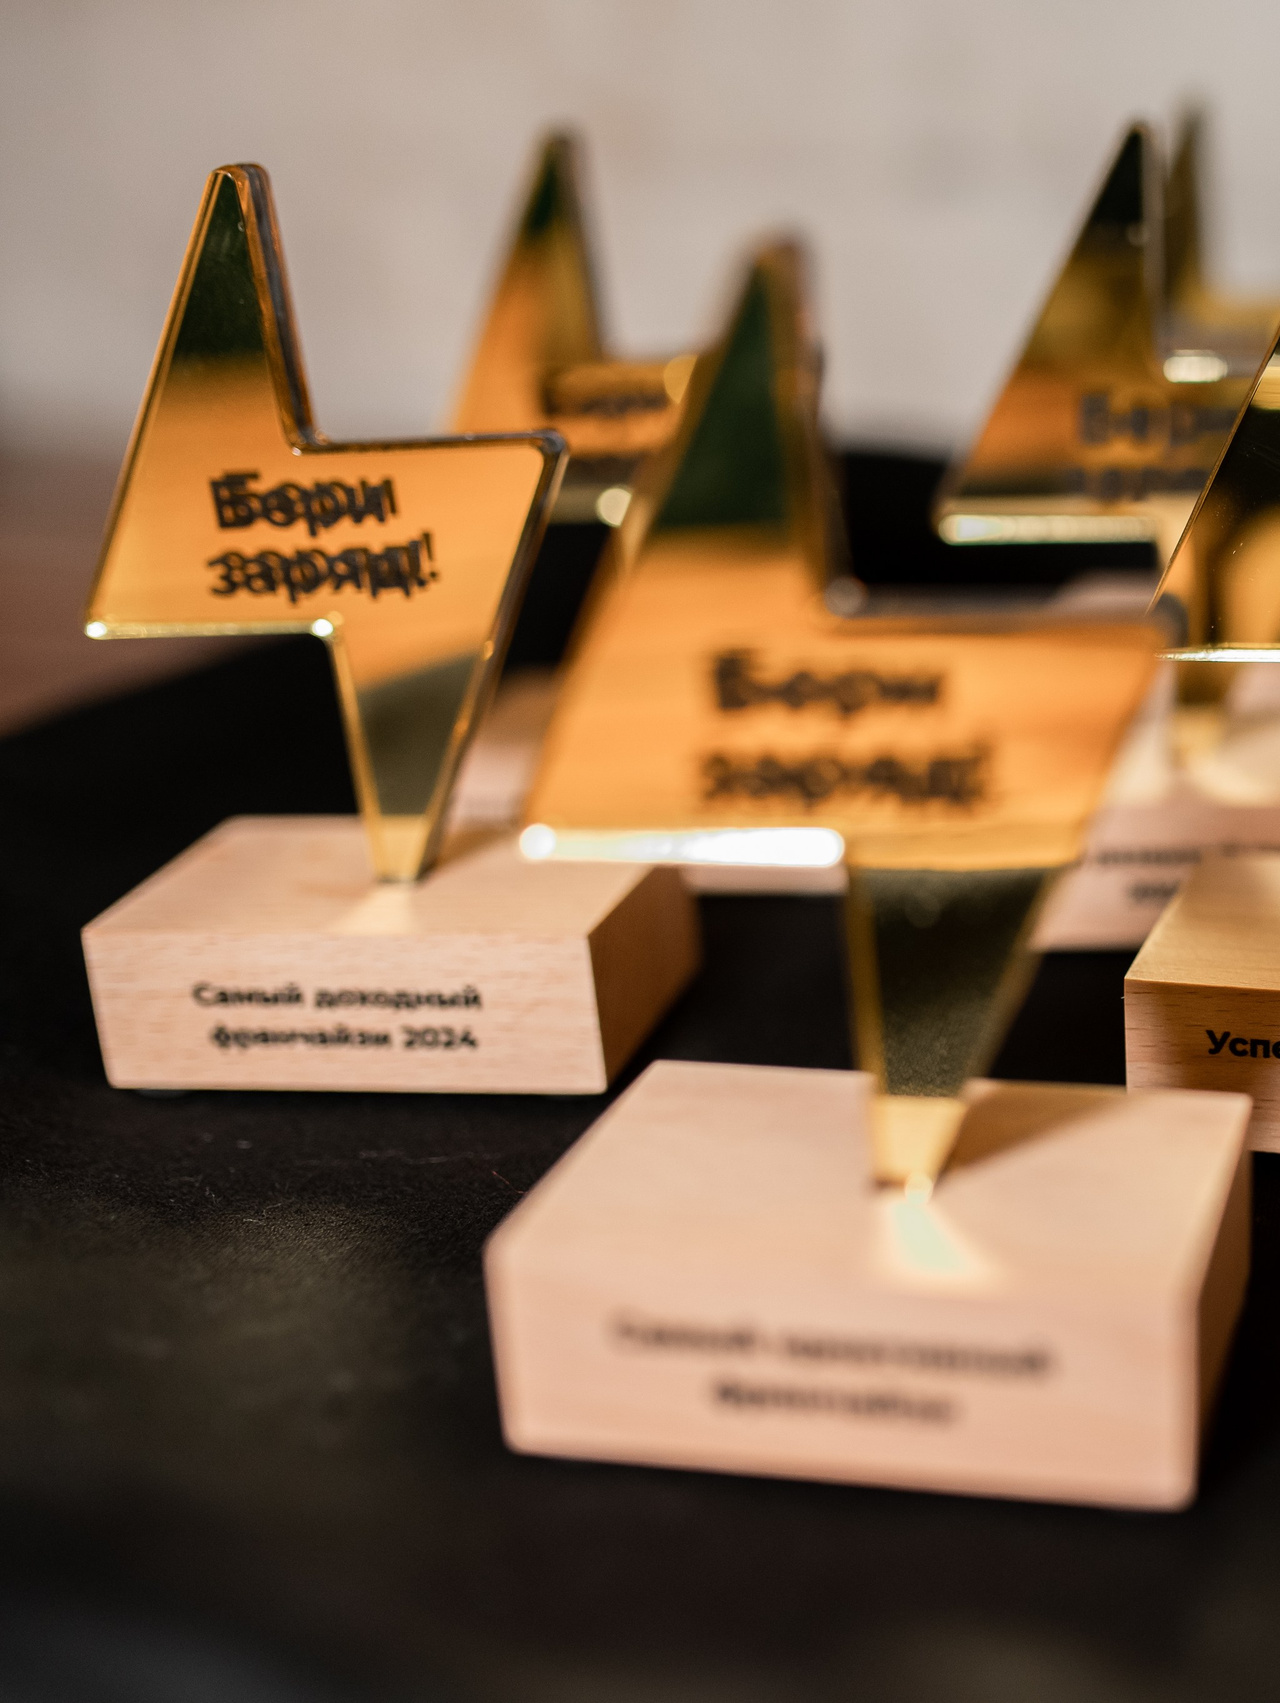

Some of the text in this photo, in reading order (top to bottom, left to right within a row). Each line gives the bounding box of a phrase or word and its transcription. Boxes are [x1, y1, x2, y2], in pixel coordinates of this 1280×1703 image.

[209, 469, 397, 538] Бери
[192, 982, 483, 1011] Самый доходный
[211, 1020, 479, 1053] франчайзи 2024
